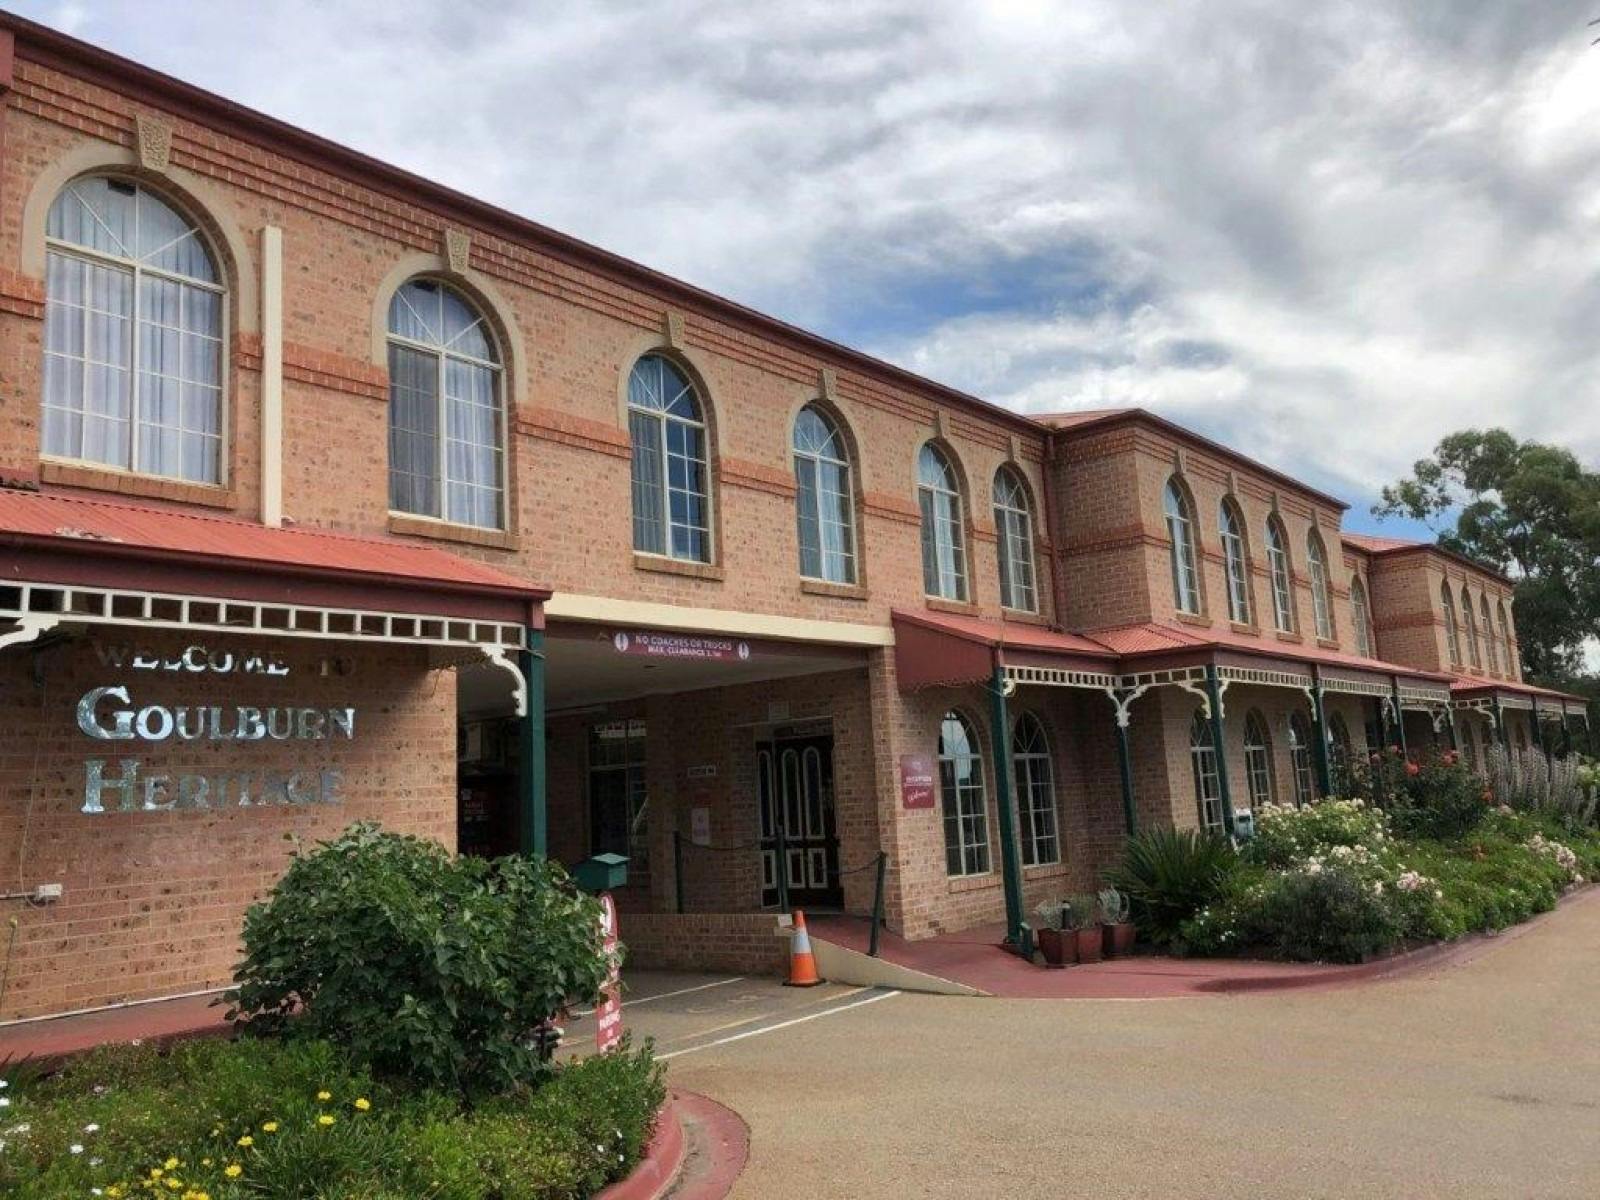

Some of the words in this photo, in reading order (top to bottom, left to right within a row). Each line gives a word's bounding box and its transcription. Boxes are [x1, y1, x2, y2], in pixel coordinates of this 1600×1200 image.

[635, 635, 649, 645] NO
[651, 636, 689, 648] COACHES
[690, 638, 702, 648] OR
[703, 639, 732, 651] TRUCKS
